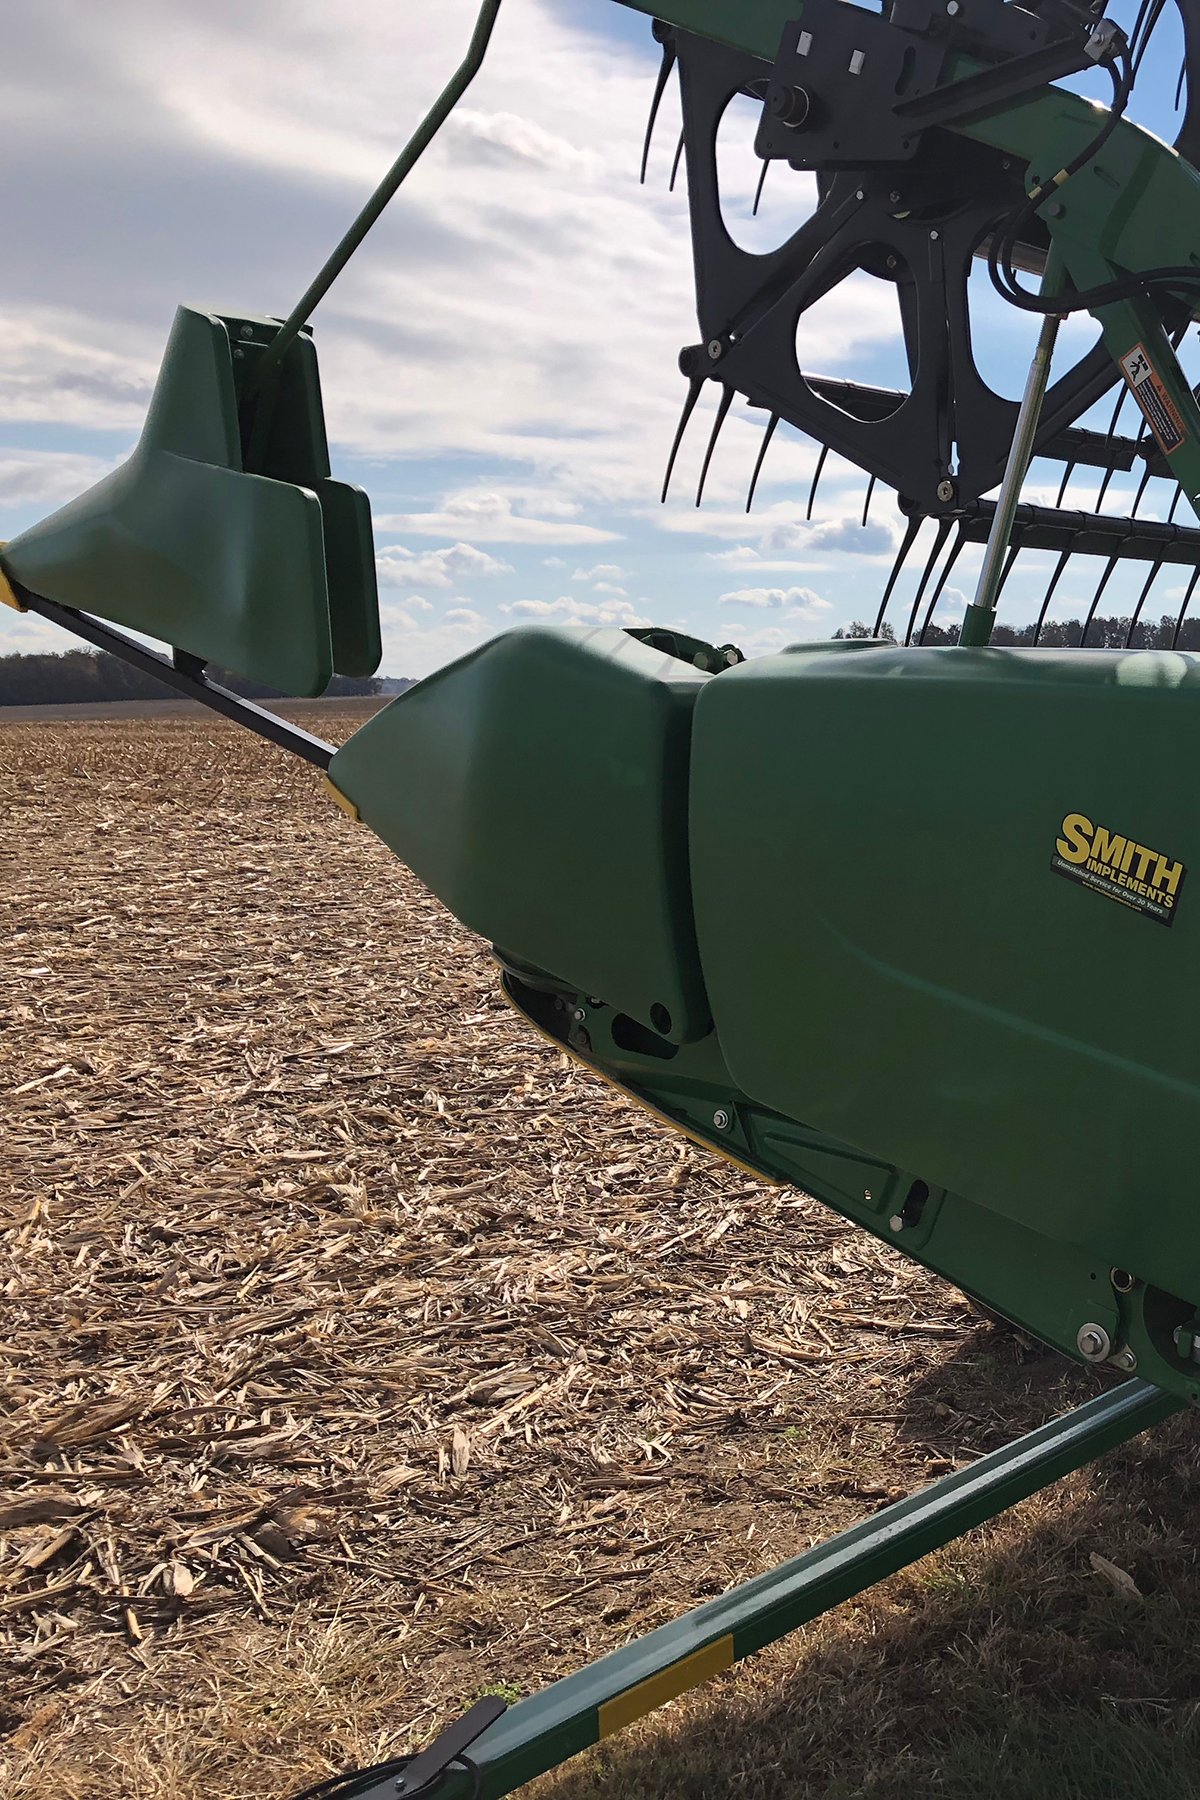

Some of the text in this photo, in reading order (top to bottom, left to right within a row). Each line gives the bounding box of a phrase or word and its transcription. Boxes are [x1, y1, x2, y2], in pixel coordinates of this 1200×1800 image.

[1161, 391, 1185, 431] WARNING
[1056, 813, 1184, 896] SMITH
[1056, 860, 1091, 880] Unmatched
[1089, 874, 1113, 890] Service
[1112, 886, 1122, 895] for
[1122, 890, 1137, 902] Over
[1146, 901, 1164, 914] Years
[1086, 858, 1175, 908] IMPLEMENTS
